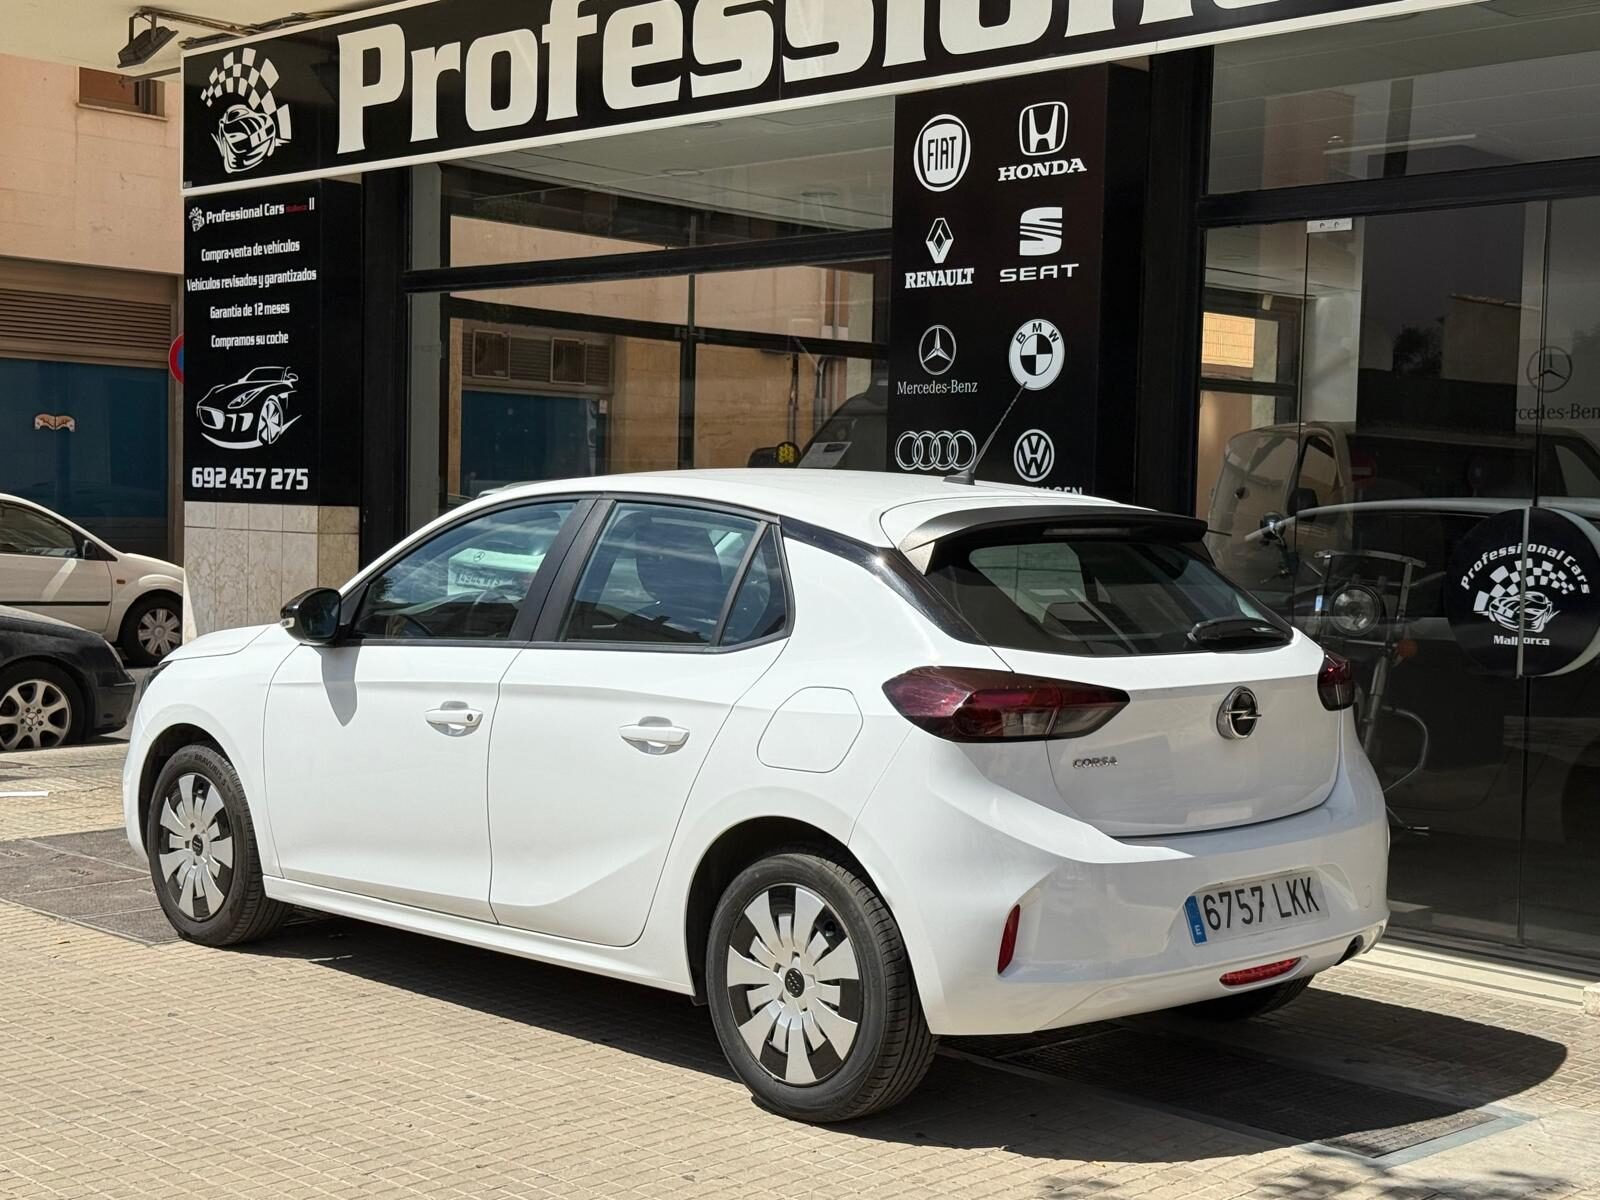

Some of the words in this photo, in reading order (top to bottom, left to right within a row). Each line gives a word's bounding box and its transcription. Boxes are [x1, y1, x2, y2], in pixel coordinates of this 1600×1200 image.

[926, 135, 958, 172] FIAT
[997, 157, 1088, 182] HONDA
[206, 204, 263, 224] Professional
[264, 203, 285, 216] Cars
[201, 244, 252, 263] Compra-venta
[252, 243, 263, 256] de
[263, 239, 300, 254] vehículos
[221, 273, 257, 288] revisados
[258, 274, 264, 288] y
[264, 267, 317, 288] garantizados
[904, 267, 975, 289] RENAULT
[999, 263, 1080, 283] SEAT
[210, 304, 242, 319] Garantía
[242, 304, 253, 316] de
[254, 302, 264, 316] 12
[264, 303, 290, 315] meses
[211, 334, 255, 350] Compramos
[255, 335, 265, 346] su
[266, 331, 289, 344] coche
[1015, 322, 1060, 345] BMW
[897, 379, 978, 395] Mercedes-Benz
[191, 467, 227, 488] 692
[229, 467, 267, 489] 457
[270, 468, 309, 490] 275
[1460, 542, 1565, 590] Professional
[1563, 555, 1590, 594] Cars
[1493, 635, 1550, 646] Mallorca
[1072, 756, 1118, 768] CORSA
[1203, 885, 1265, 930] 6757
[1271, 876, 1320, 919] LKK
